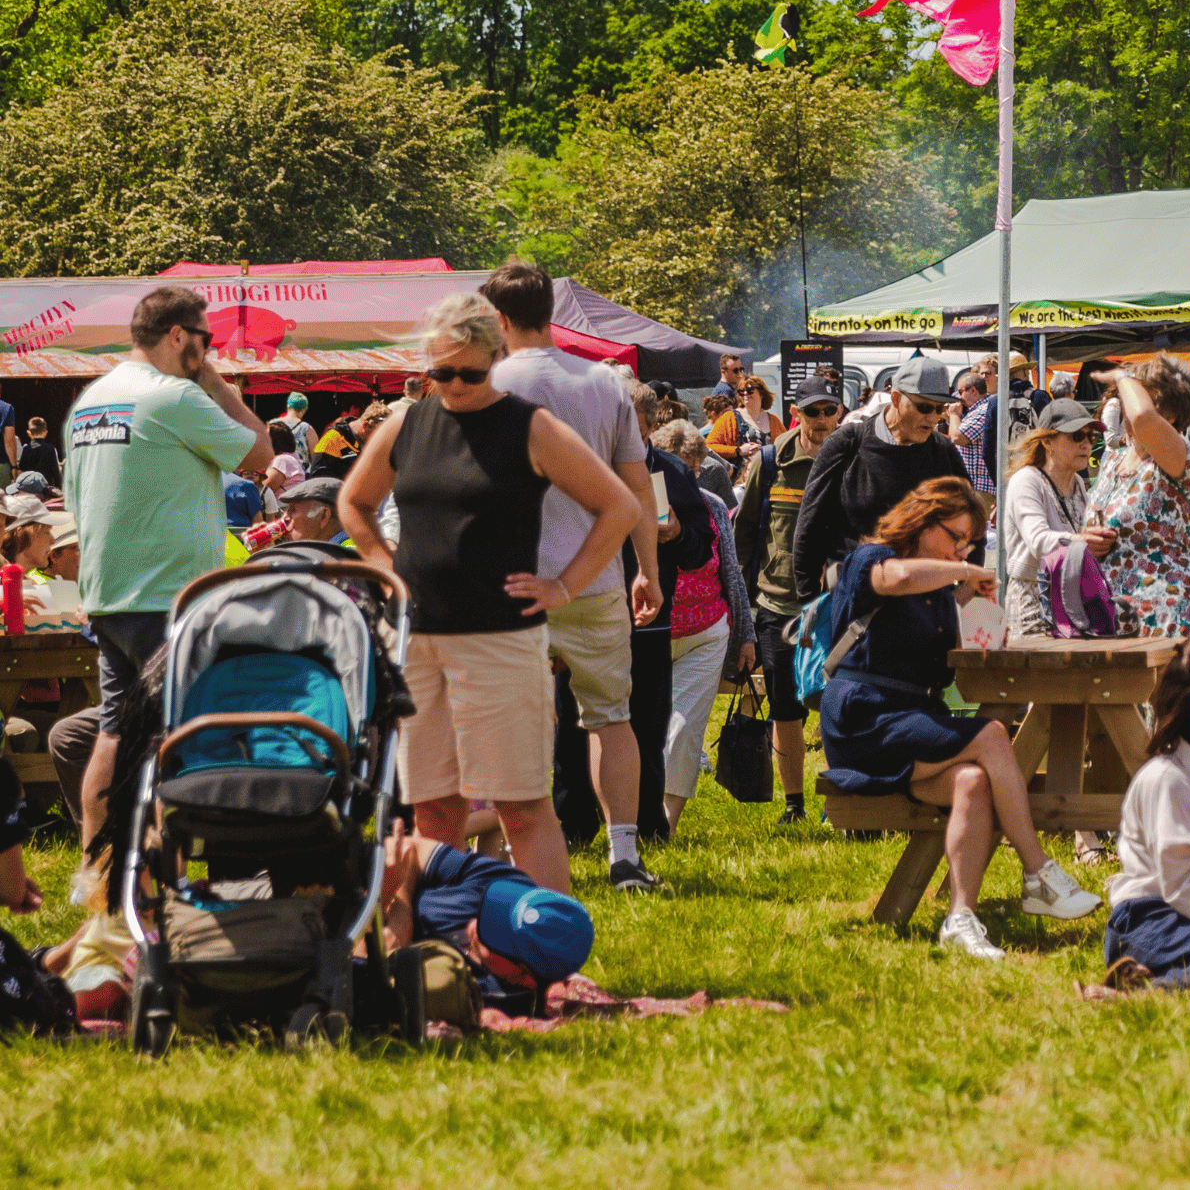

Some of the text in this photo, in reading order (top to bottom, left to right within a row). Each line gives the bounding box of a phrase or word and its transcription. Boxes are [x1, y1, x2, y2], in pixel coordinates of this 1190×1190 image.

[3, 297, 76, 344] MOCHYN
[874, 318, 891, 331] on
[894, 315, 916, 330] the
[919, 317, 936, 333] go
[1019, 311, 1035, 325] We
[1037, 310, 1055, 323] are
[1058, 307, 1076, 322] the
[1078, 307, 1101, 321] best
[16, 317, 73, 359] RHOST
[72, 423, 127, 448] patagonia
